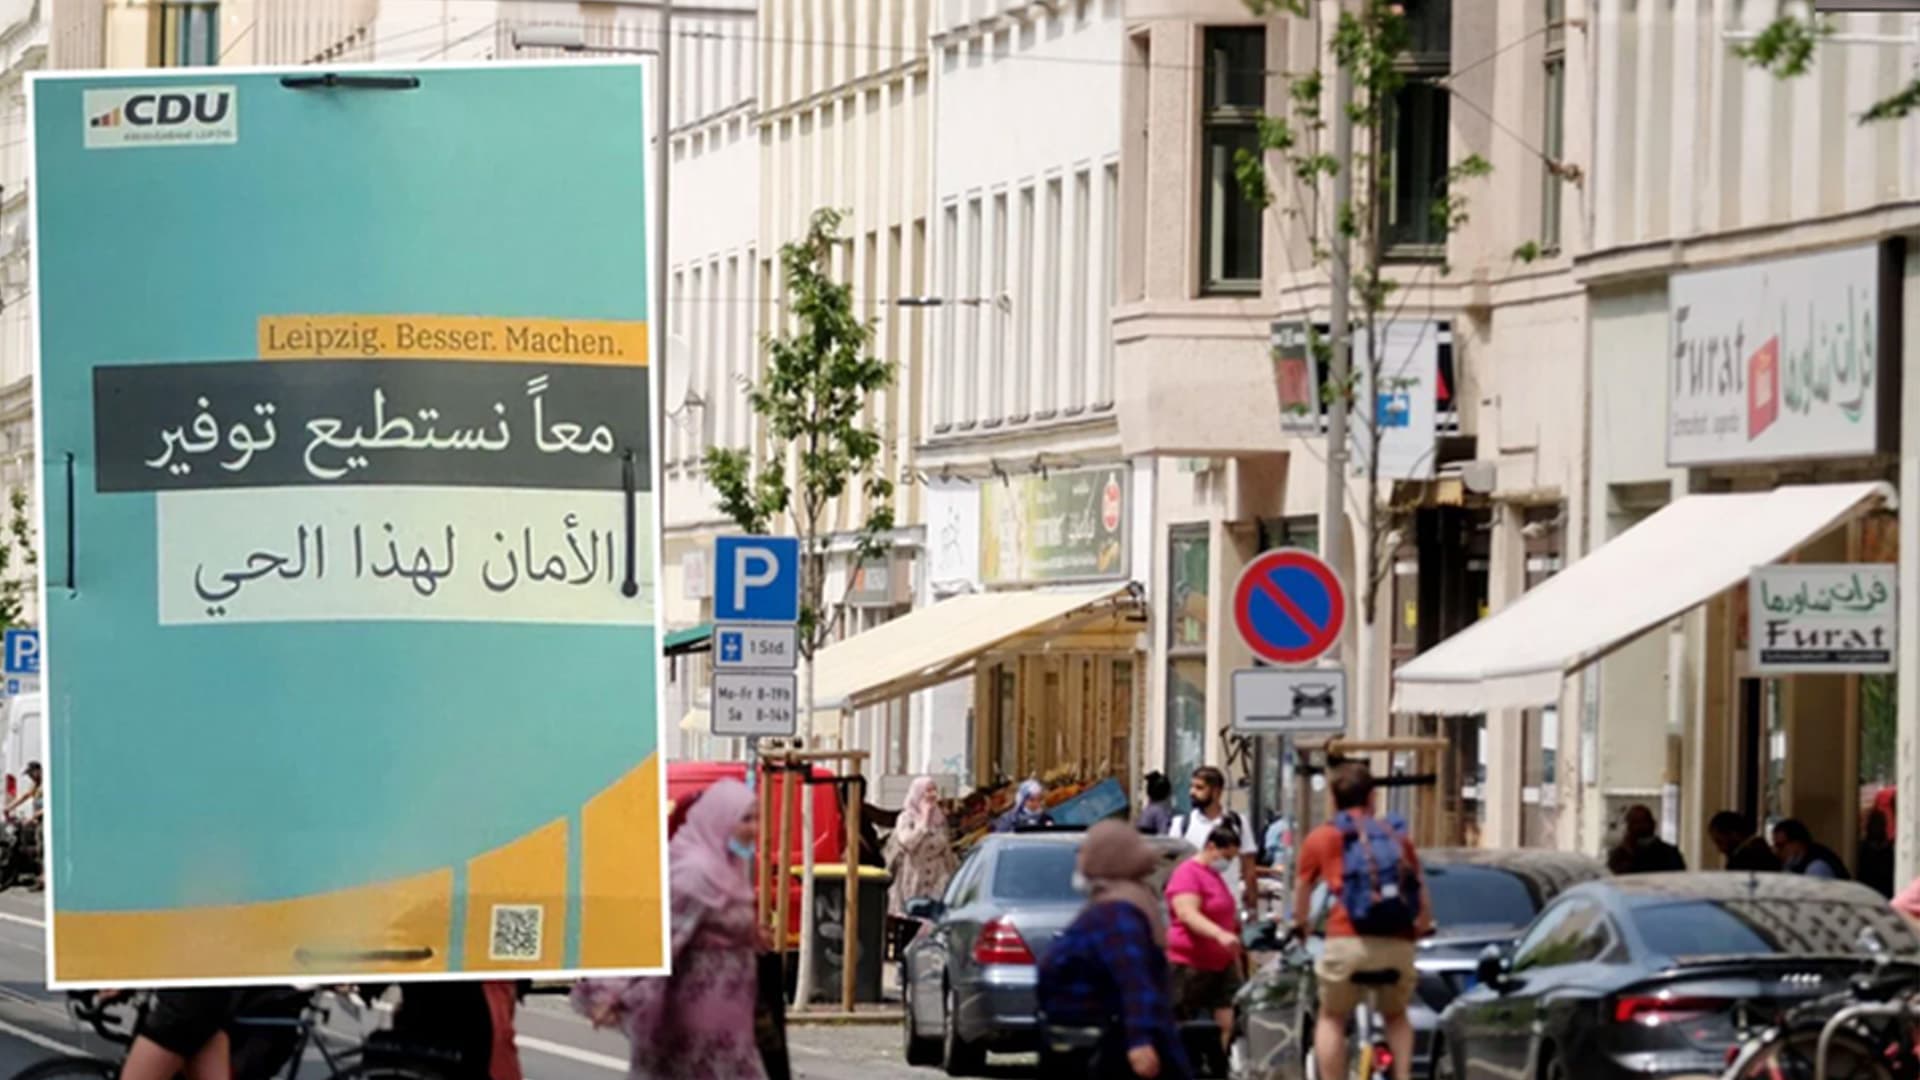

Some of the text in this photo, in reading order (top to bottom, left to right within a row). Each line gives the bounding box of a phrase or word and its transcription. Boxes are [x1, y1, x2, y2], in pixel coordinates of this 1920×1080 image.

[124, 93, 229, 125] CDU
[268, 322, 625, 357] Leipzig. Besser. Machen.
[1675, 305, 1745, 397] Furat
[145, 374, 614, 479] معاً نستطيع توفير
[194, 512, 614, 616] الأمان لهذا الحي
[733, 547, 779, 611] P
[1765, 619, 1885, 647] Furat
[14, 635, 38, 668] P
[718, 686, 790, 701] Mo-Fr 8-19h
[728, 706, 789, 722] Sa 8-14h
